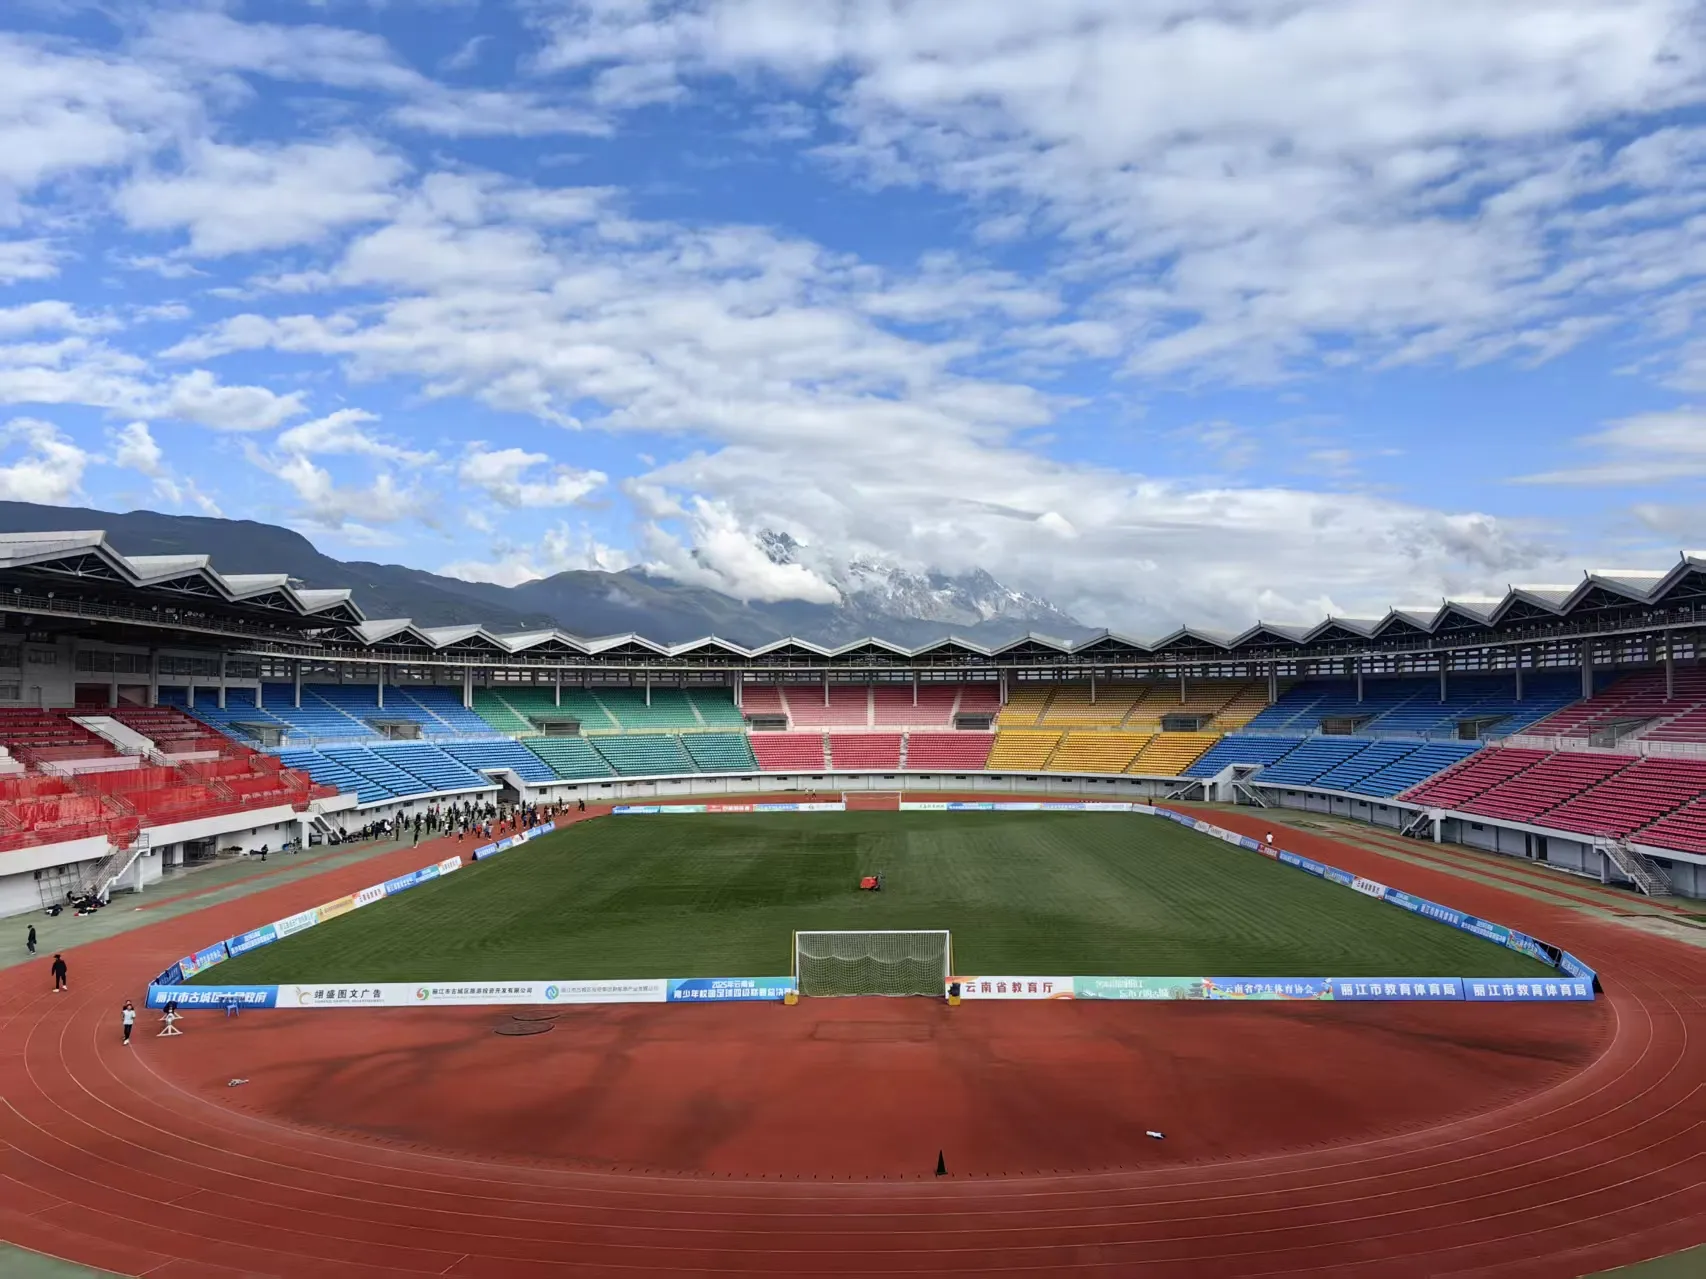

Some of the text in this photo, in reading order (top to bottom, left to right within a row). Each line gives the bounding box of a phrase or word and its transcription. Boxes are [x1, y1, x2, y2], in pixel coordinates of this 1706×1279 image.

[965, 982, 1053, 993] 云南省教育厅
[1225, 983, 1313, 994] 云南省学生体育协会
[1340, 983, 1456, 996] 丽江市教育体育局
[1473, 983, 1587, 997] 丽江市教育体育局
